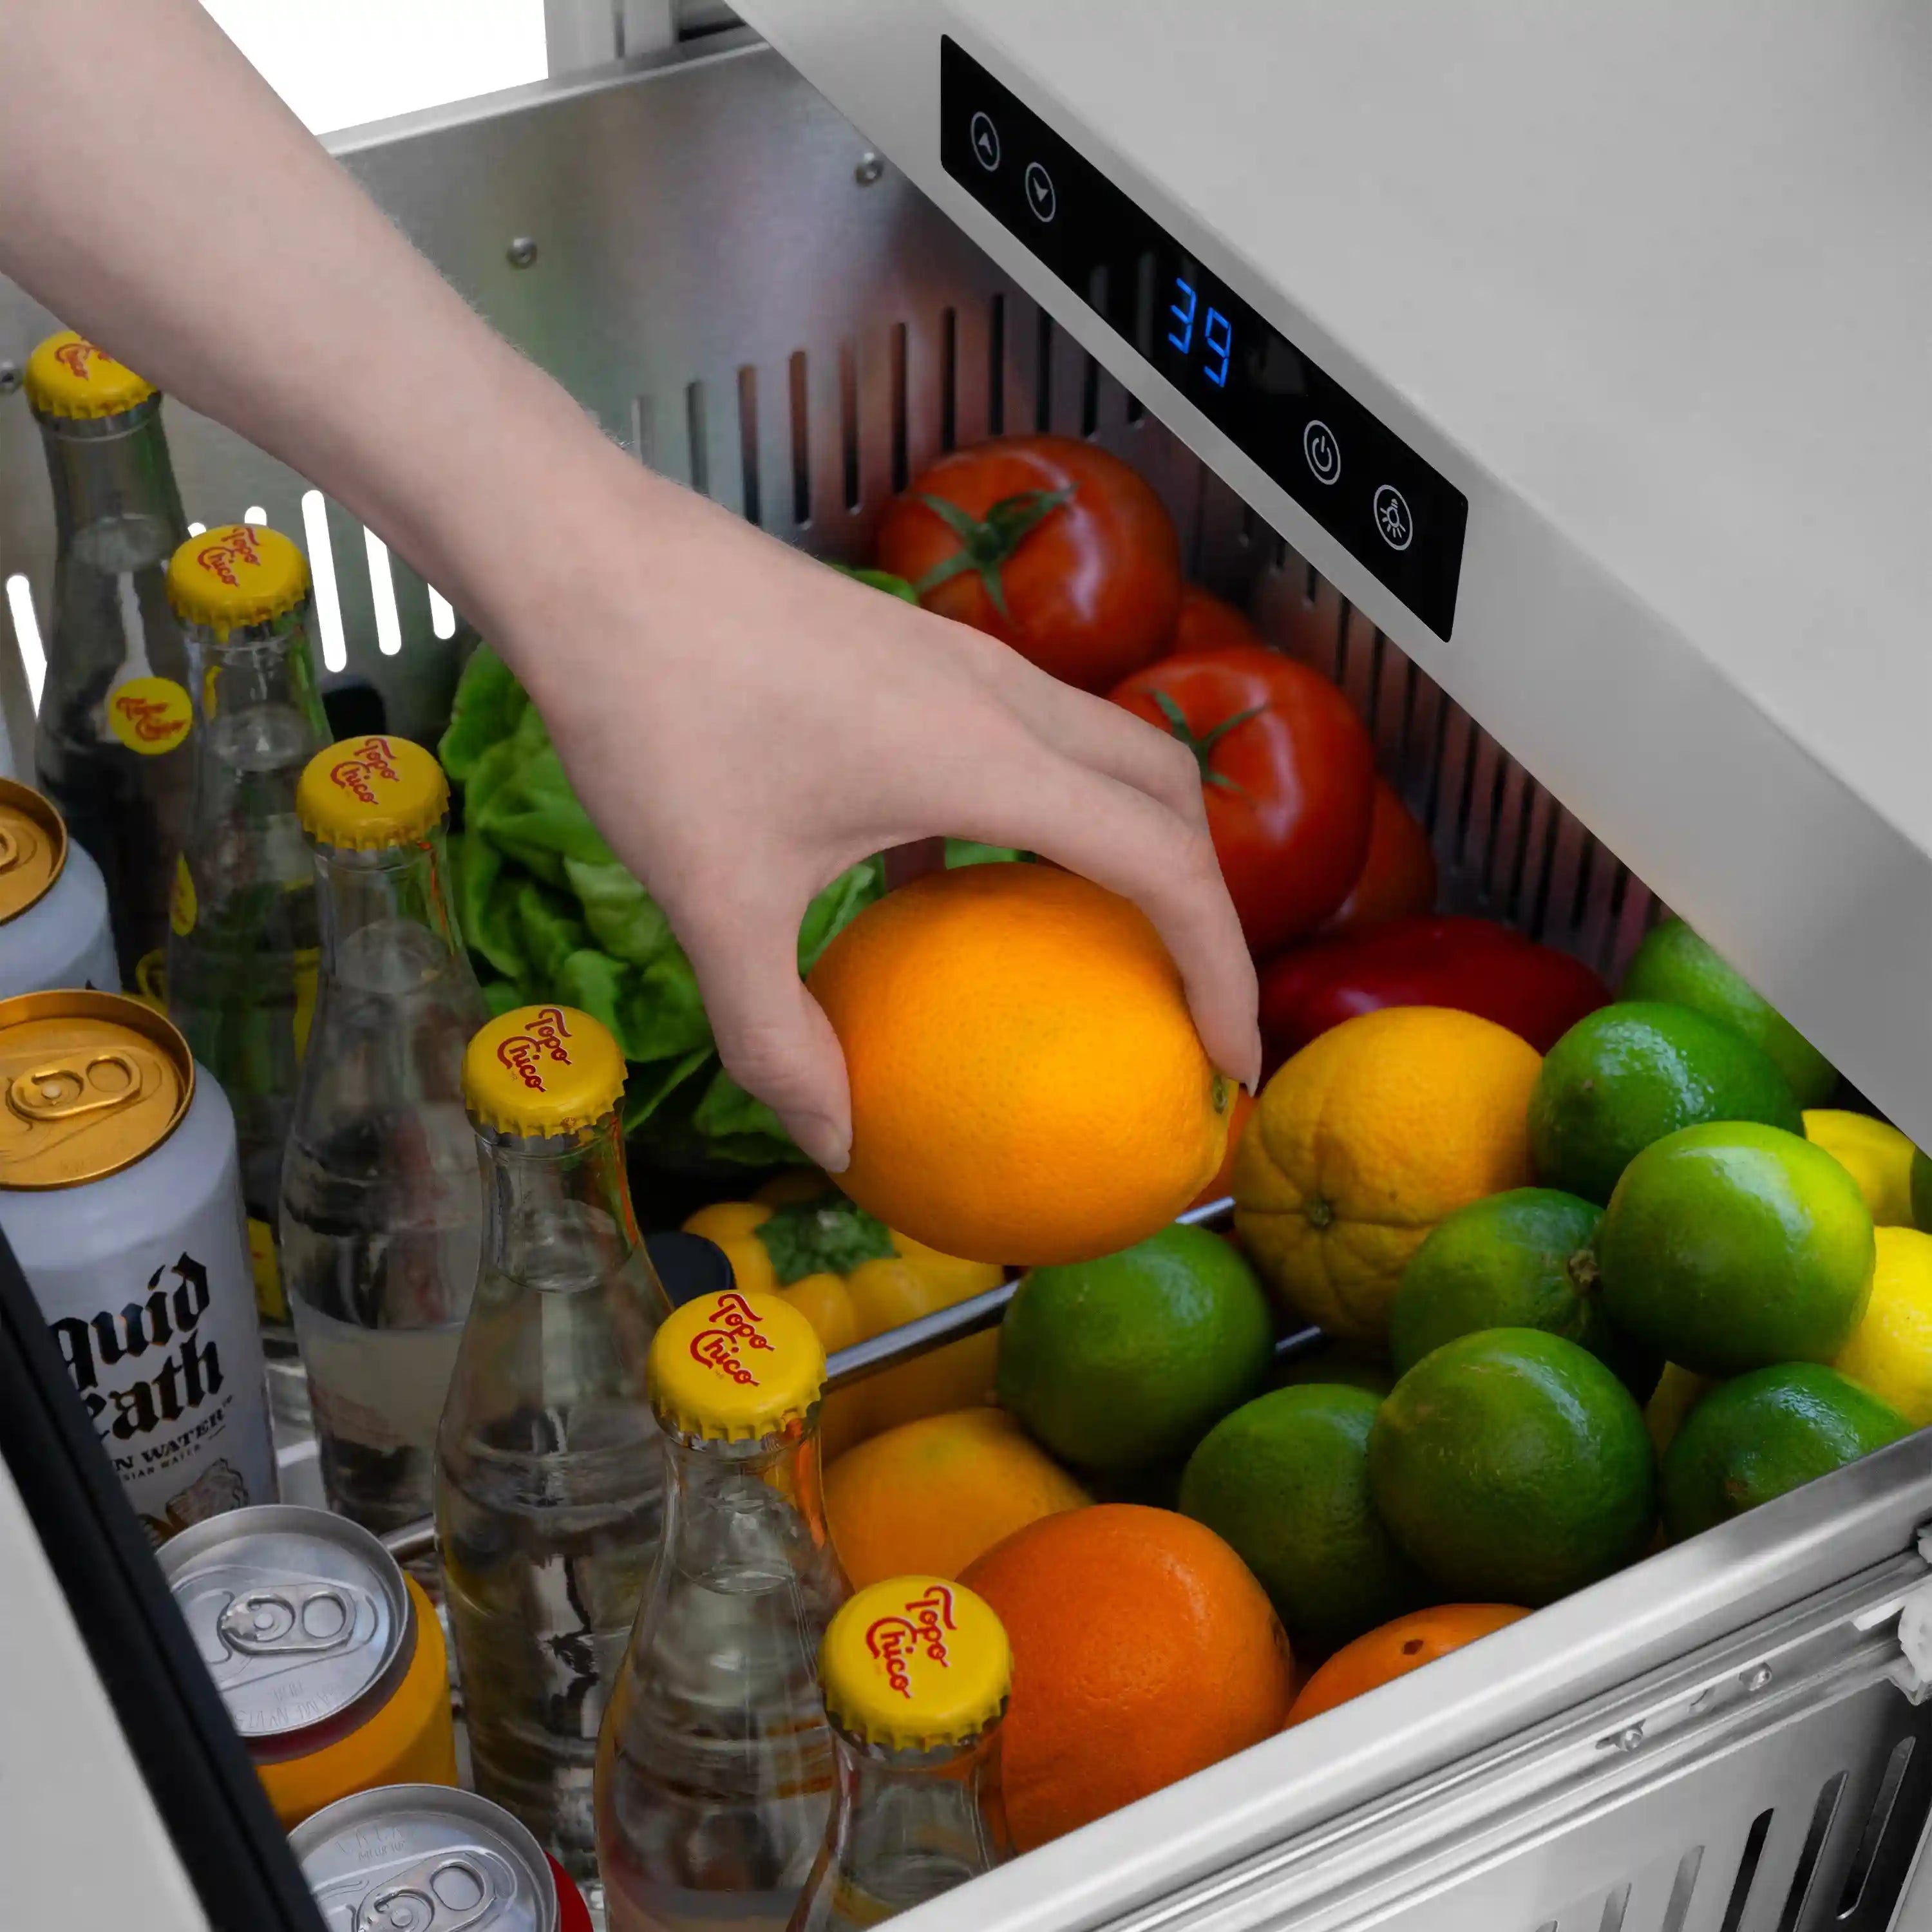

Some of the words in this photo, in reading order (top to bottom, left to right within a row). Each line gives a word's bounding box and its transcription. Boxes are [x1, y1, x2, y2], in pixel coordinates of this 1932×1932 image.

[1168, 278, 1231, 388] 39
[197, 546, 240, 589] Chico
[330, 761, 379, 805] Chico
[354, 738, 400, 782] Topo
[497, 1036, 546, 1093] Chico
[525, 1009, 572, 1066] Topo
[50, 1251, 210, 1391] quid
[708, 1293, 776, 1352] Topo
[690, 1329, 760, 1387] Chico
[905, 1586, 957, 1668] Topo
[866, 1616, 917, 1699] Chico
